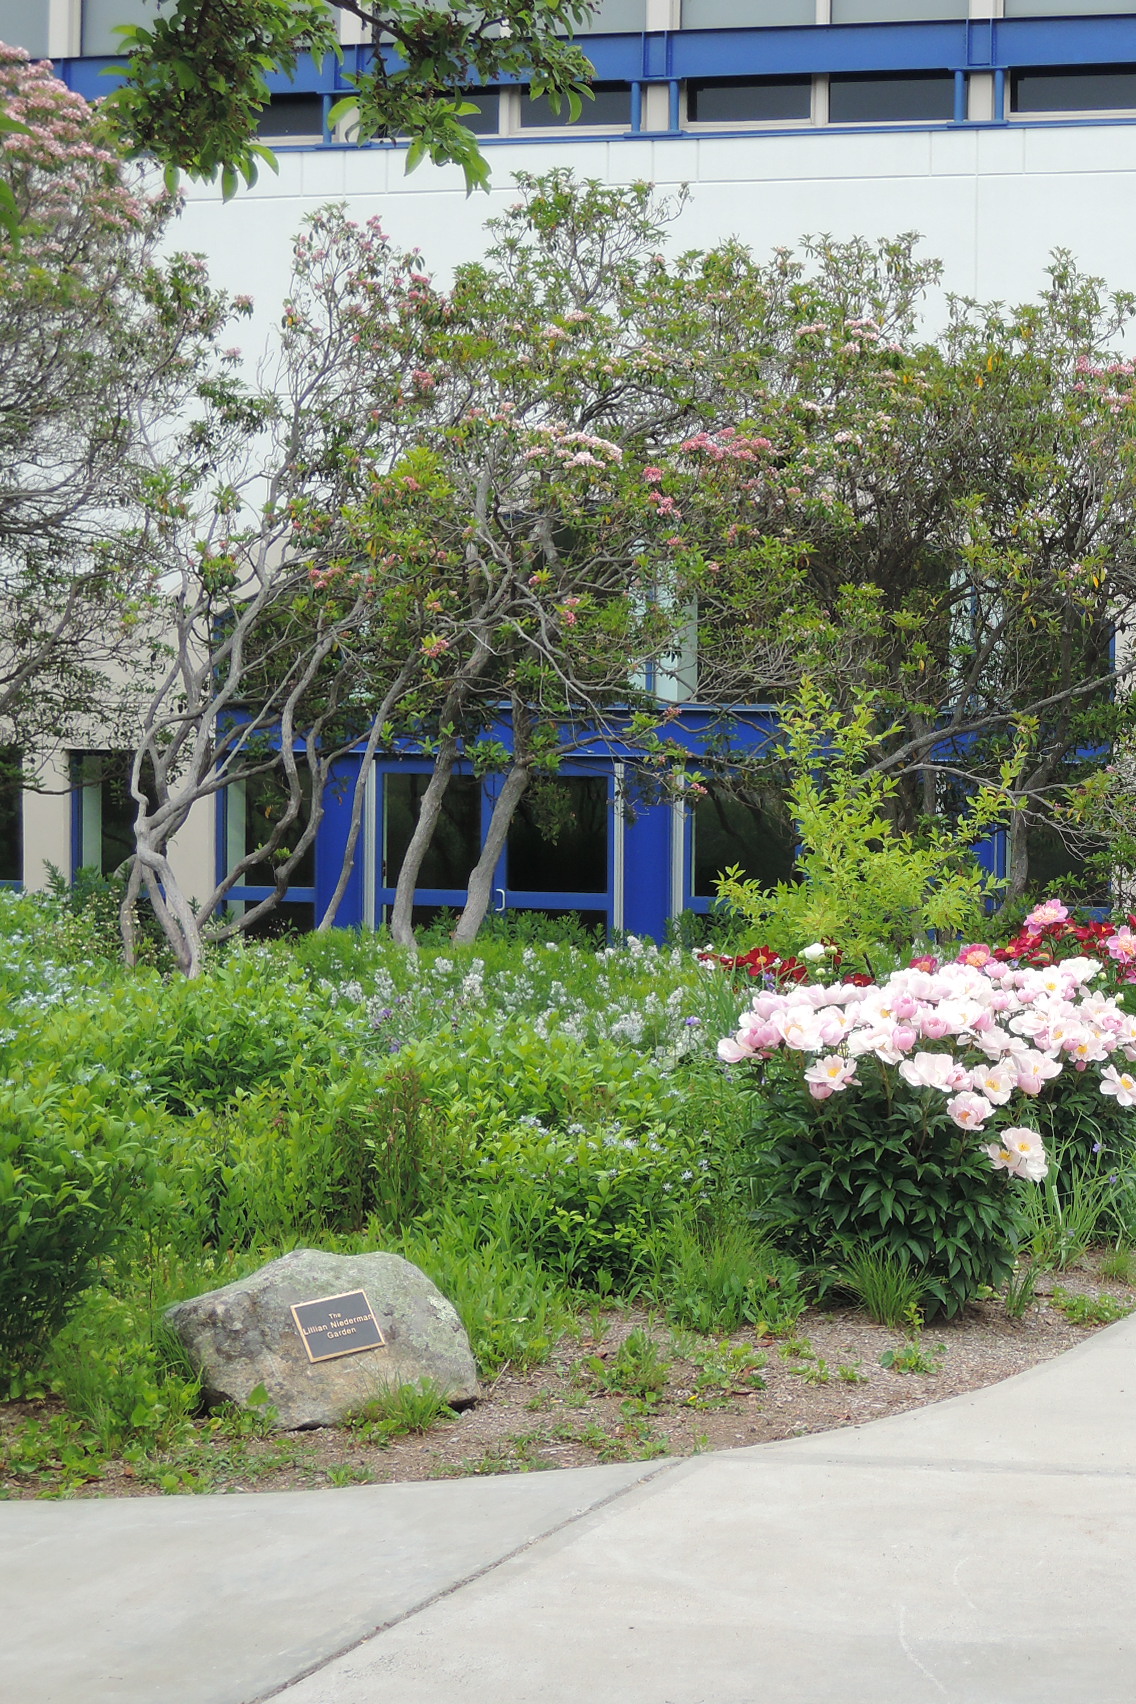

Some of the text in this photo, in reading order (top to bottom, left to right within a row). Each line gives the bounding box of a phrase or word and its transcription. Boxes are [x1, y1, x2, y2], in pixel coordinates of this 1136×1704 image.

[328, 1312, 341, 1320] The
[302, 1313, 374, 1336] Lillian Niederman
[327, 1326, 356, 1339] Garden
